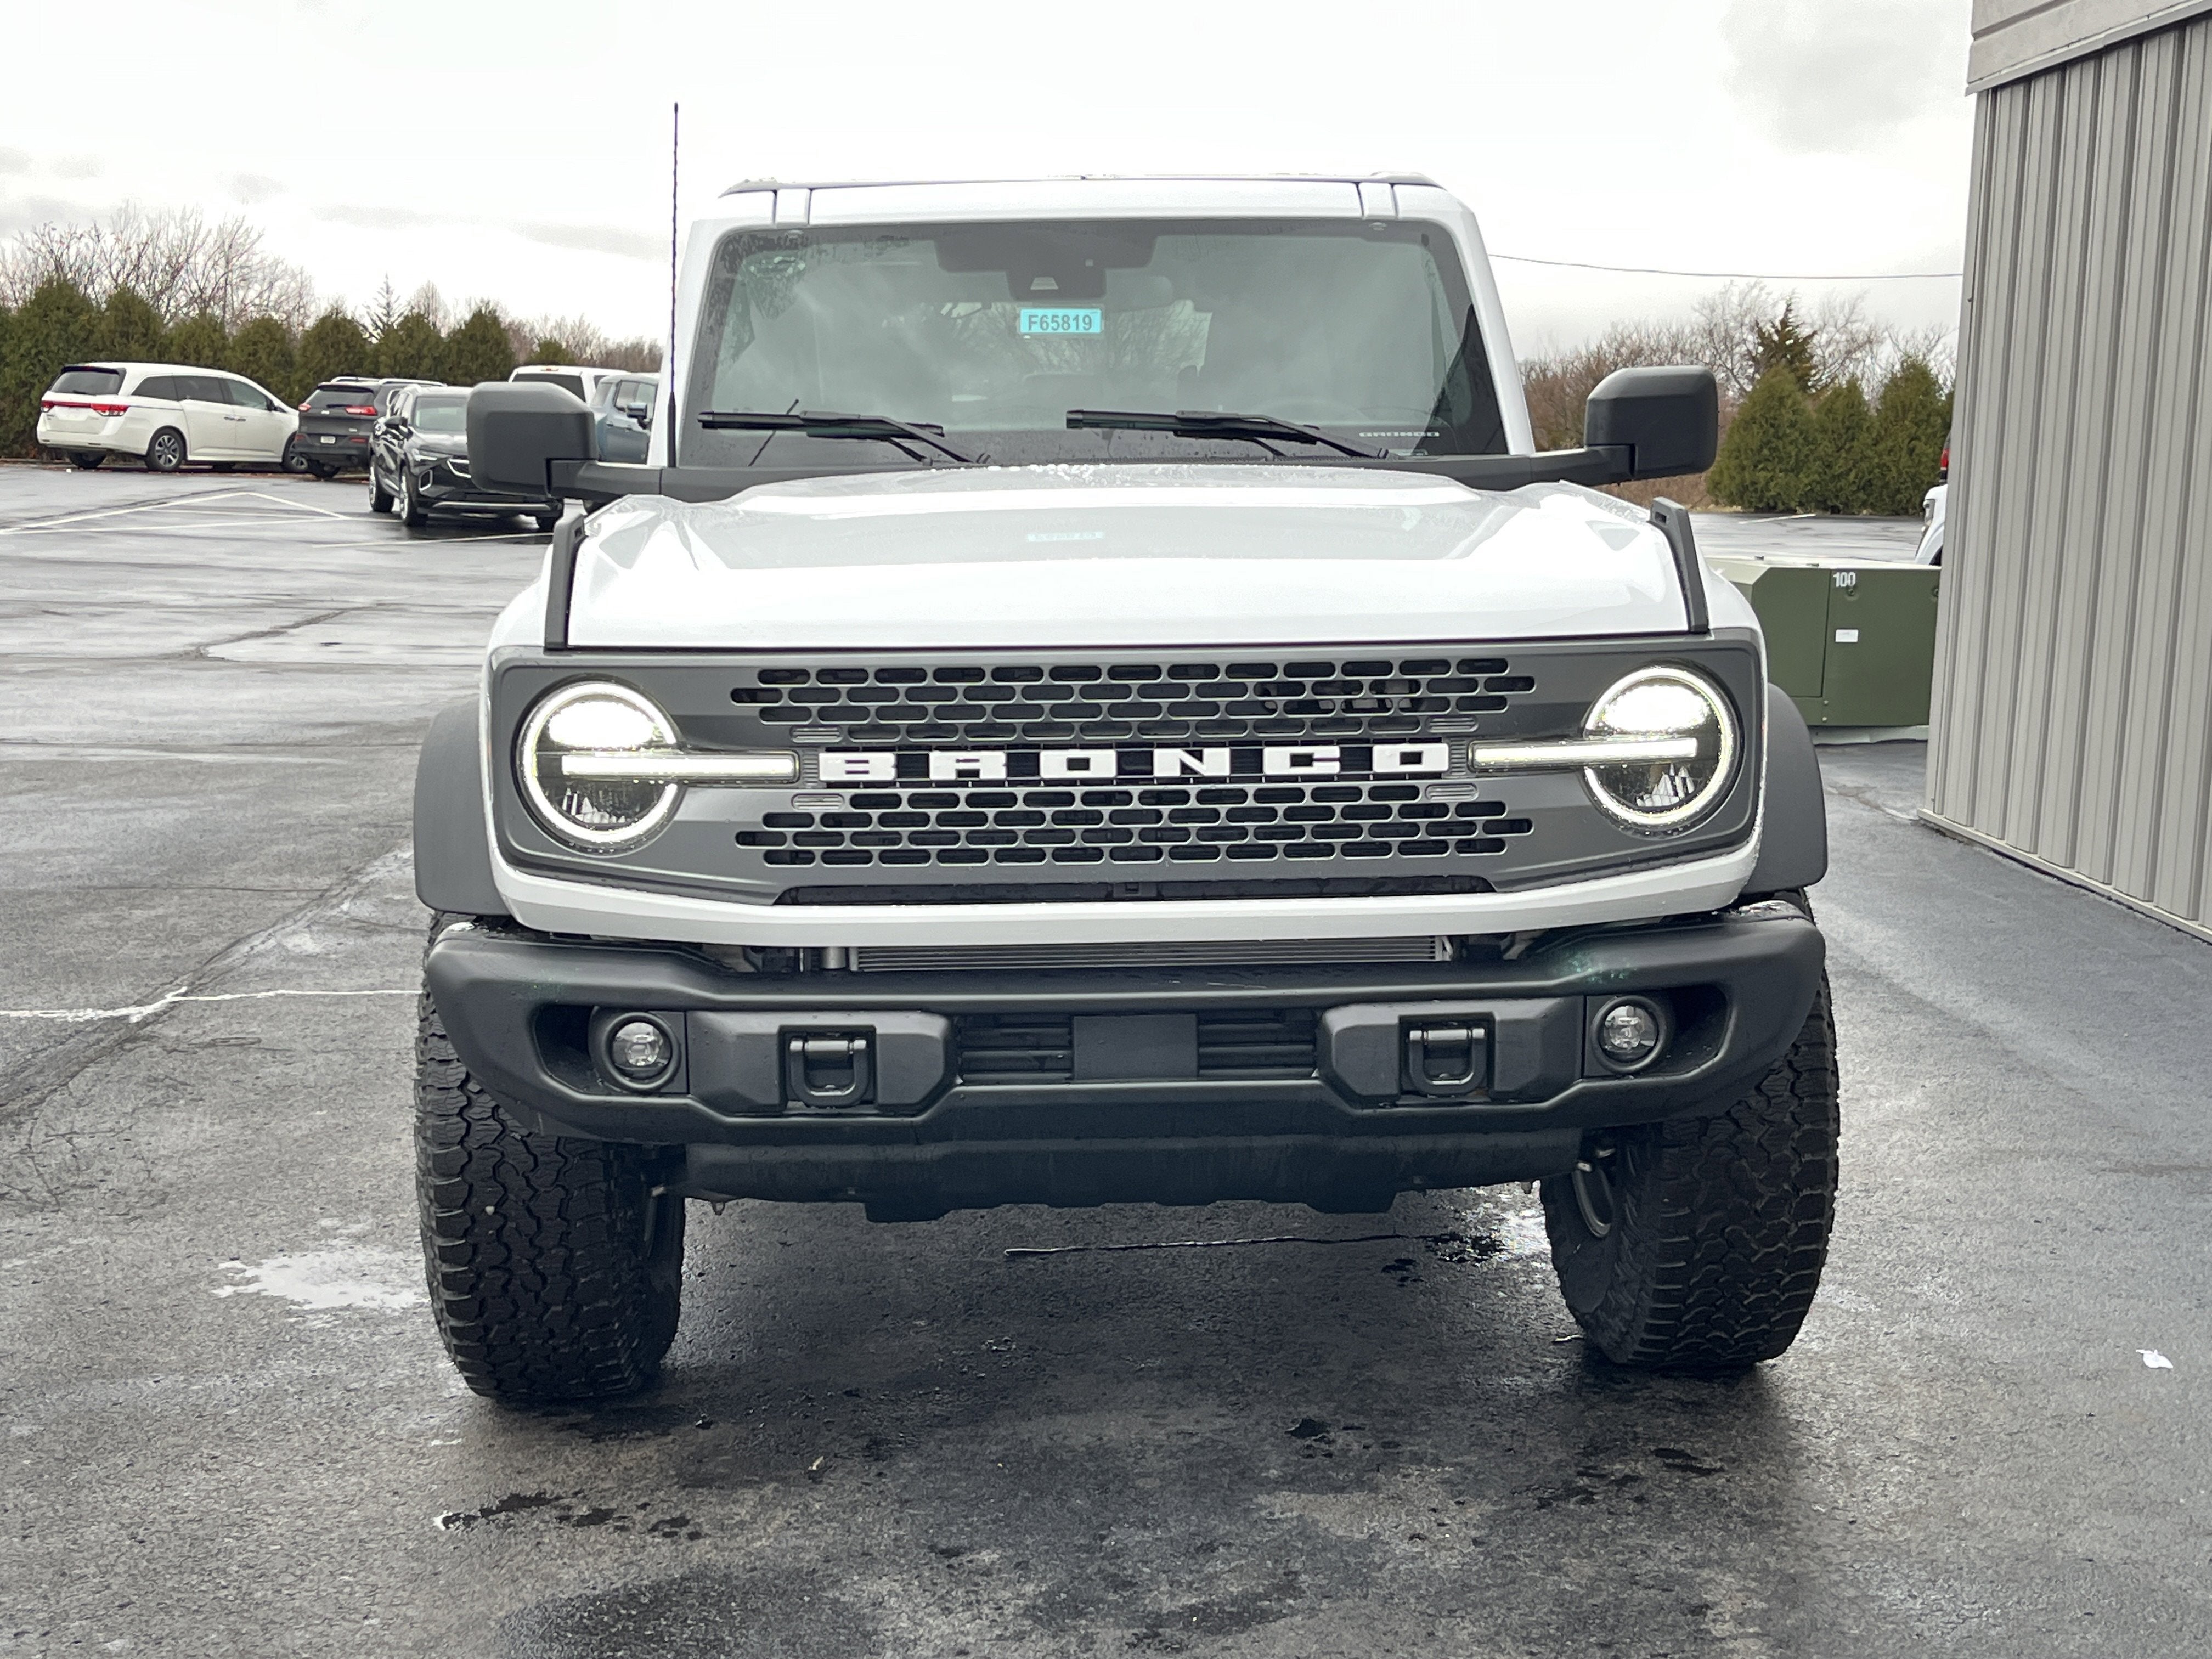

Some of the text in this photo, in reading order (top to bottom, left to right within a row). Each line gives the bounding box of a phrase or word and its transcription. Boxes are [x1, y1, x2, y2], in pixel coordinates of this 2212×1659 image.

[1028, 314, 1092, 331] F65819
[1833, 572, 1856, 588] 100
[819, 743, 1449, 781] BRONCO
